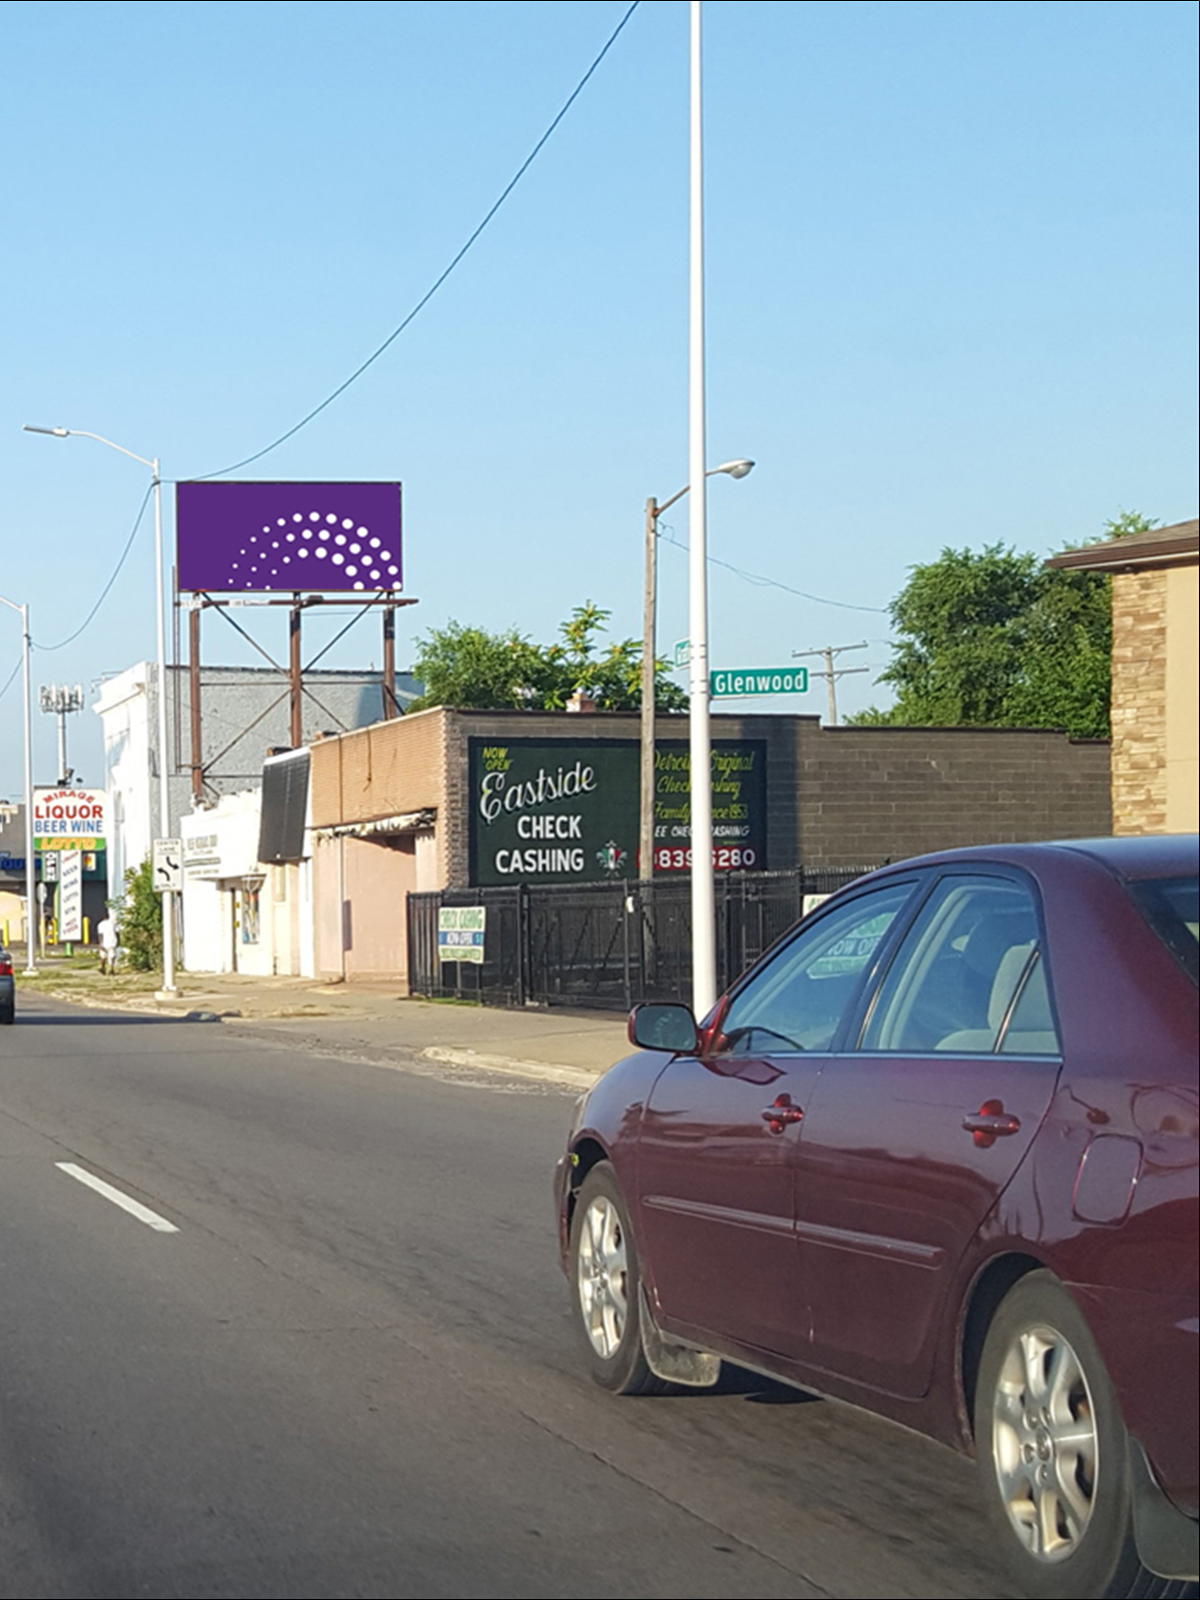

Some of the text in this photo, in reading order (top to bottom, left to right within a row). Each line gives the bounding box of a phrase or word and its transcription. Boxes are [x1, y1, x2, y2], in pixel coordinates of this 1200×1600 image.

[714, 671, 805, 693] Glenwood
[482, 747, 508, 759] NOW
[485, 759, 512, 771] OPEN
[657, 776, 691, 793] Chec
[42, 790, 95, 804] MIRAGE
[479, 761, 597, 825] Eastside
[34, 805, 104, 819] LIQUOR
[34, 820, 104, 833] BEER WINE
[517, 815, 582, 839] CHECK
[654, 825, 750, 838] EE CHEC ASHING
[40, 837, 97, 851] LOTTO
[495, 848, 584, 873] CASHING
